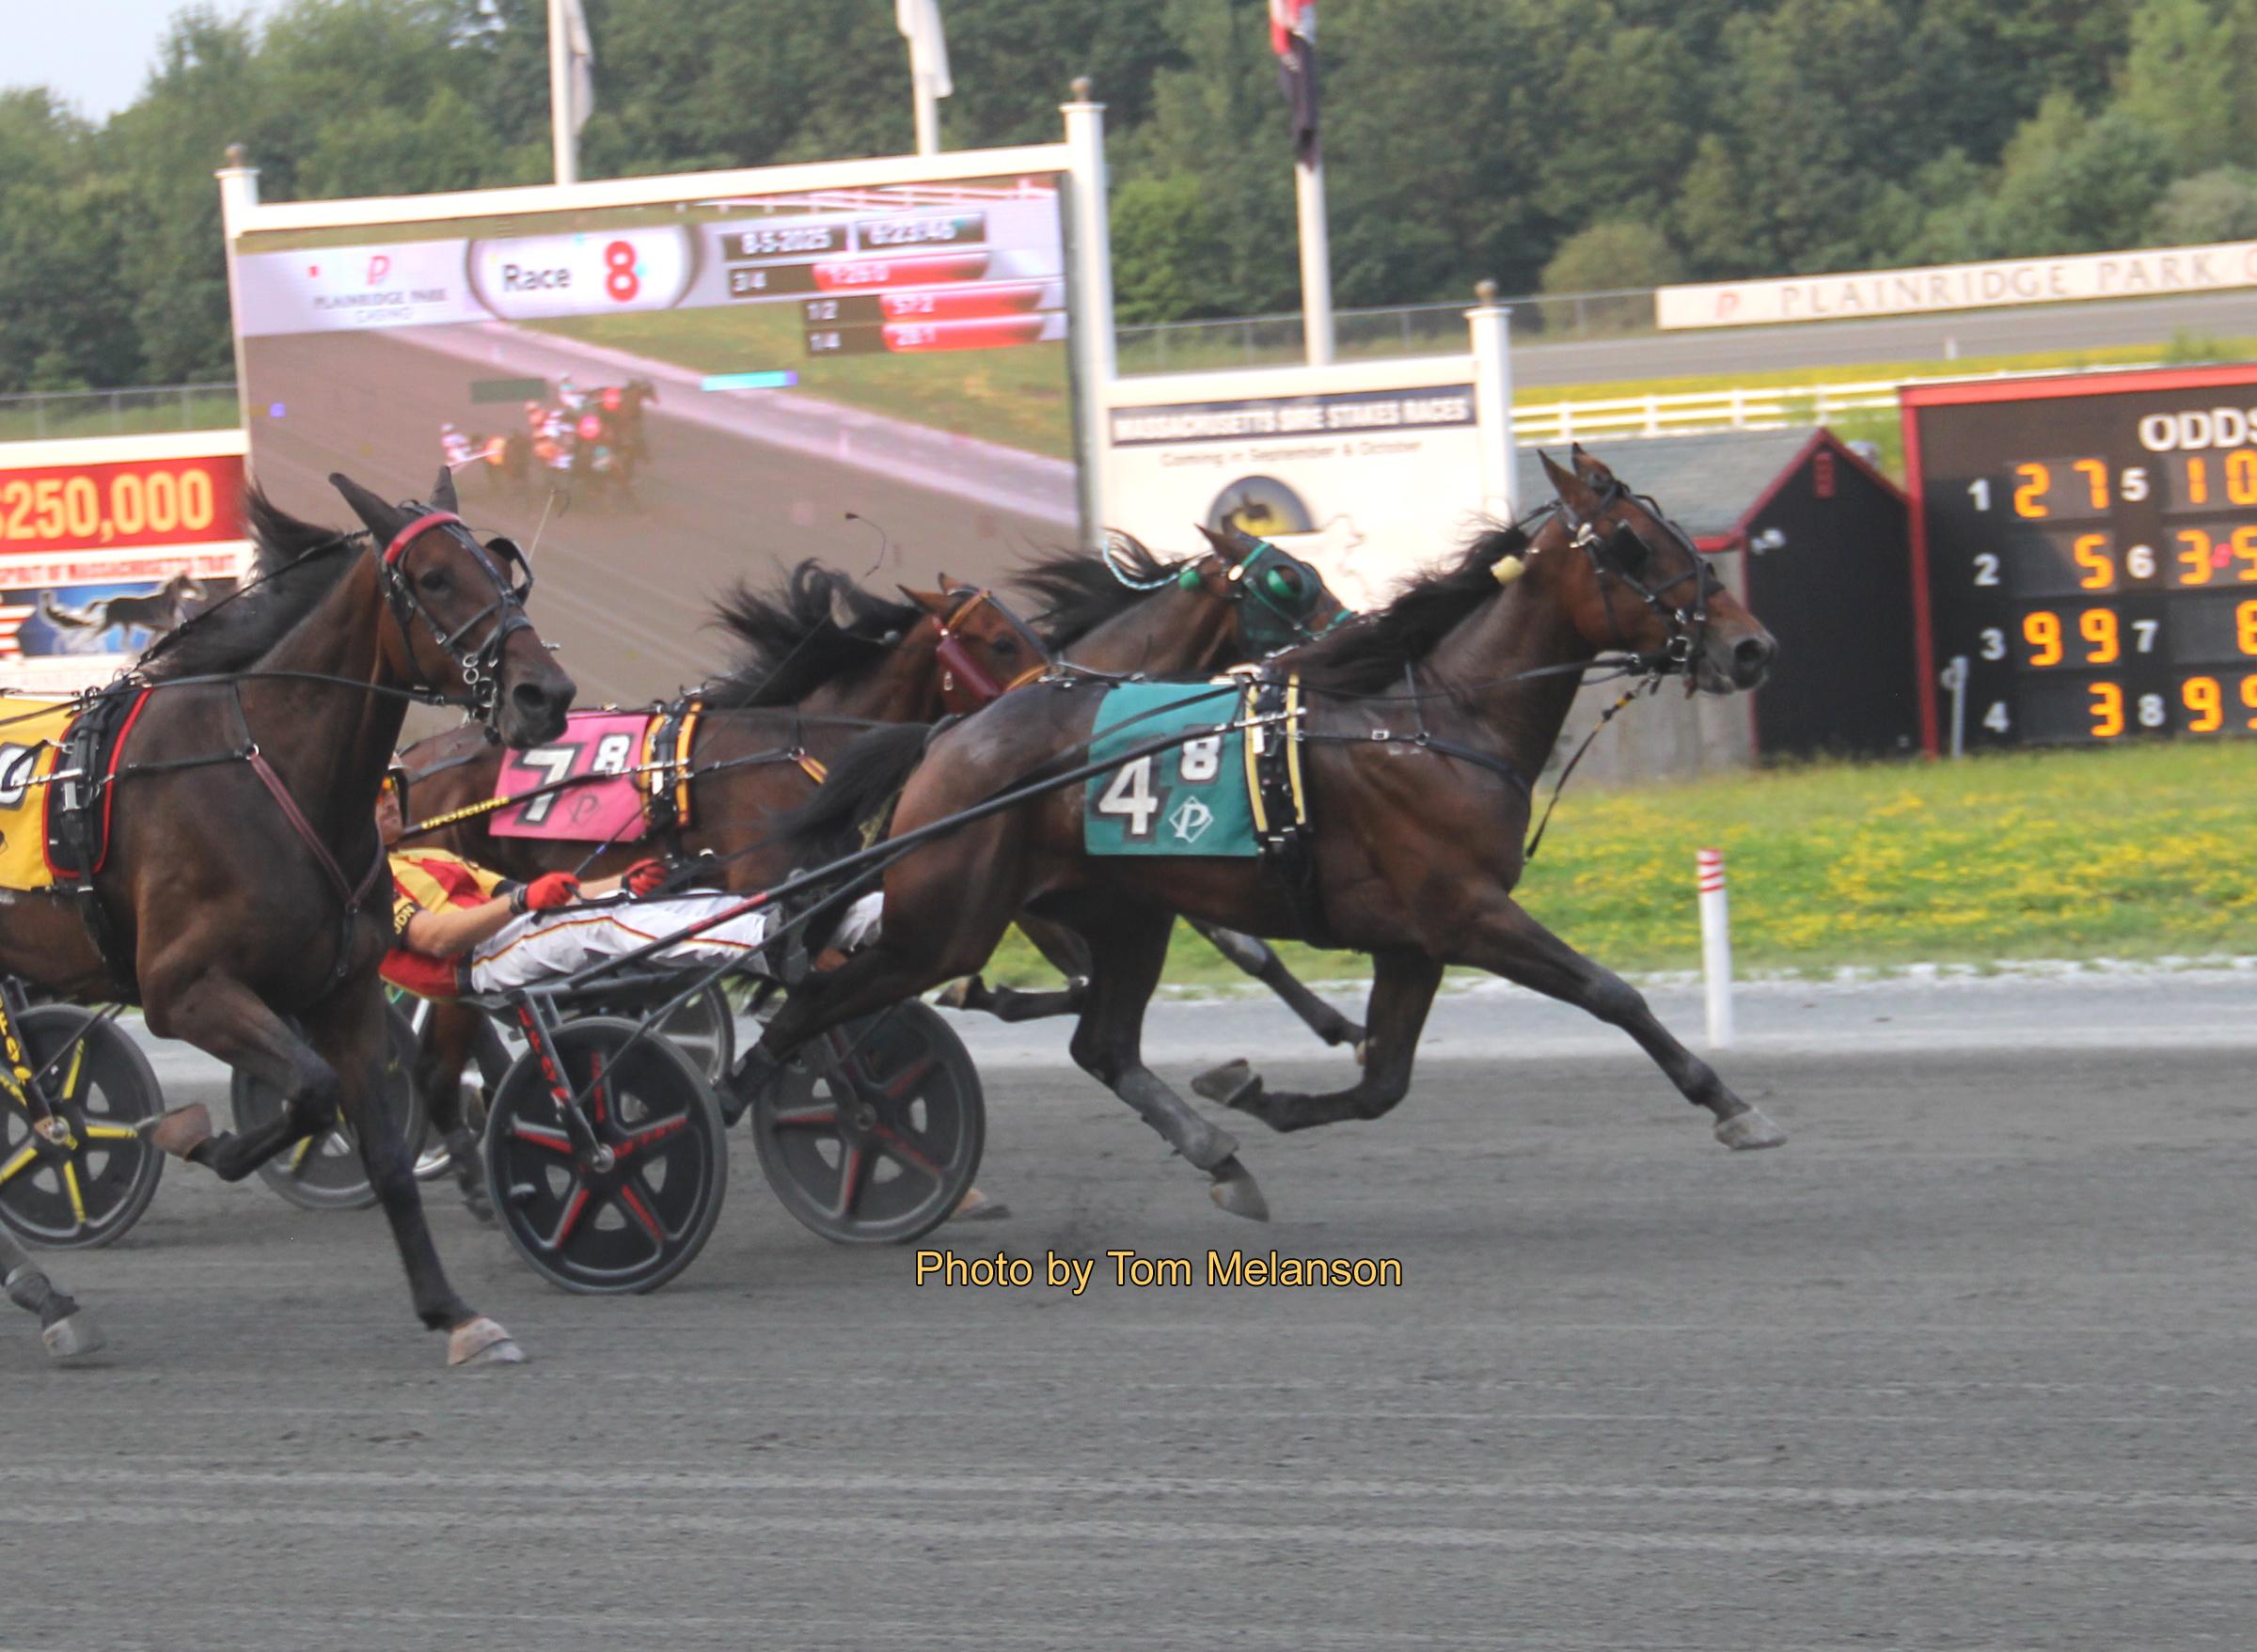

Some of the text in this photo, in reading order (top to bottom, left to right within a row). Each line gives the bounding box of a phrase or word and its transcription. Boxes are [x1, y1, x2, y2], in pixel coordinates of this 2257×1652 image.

[502, 240, 639, 302] Race 8
[1781, 264, 2069, 317] PLAINRIDGE
[2097, 252, 2223, 291] PARK
[2139, 406, 2257, 451] ODD
[0, 468, 213, 543] 250,000
[1967, 478, 1991, 511] 1
[2121, 466, 2150, 501] 5
[1973, 552, 2000, 586] 2
[2074, 533, 2115, 590] 5
[2126, 544, 2156, 579] 6
[1980, 627, 2007, 660] 3
[2131, 619, 2159, 653] 7
[1982, 700, 2011, 733] 4
[2088, 681, 2125, 737] 3
[2138, 692, 2166, 728] 8
[522, 733, 631, 822] 7 8
[1180, 729, 1222, 781] 8
[1098, 752, 1160, 835] 4
